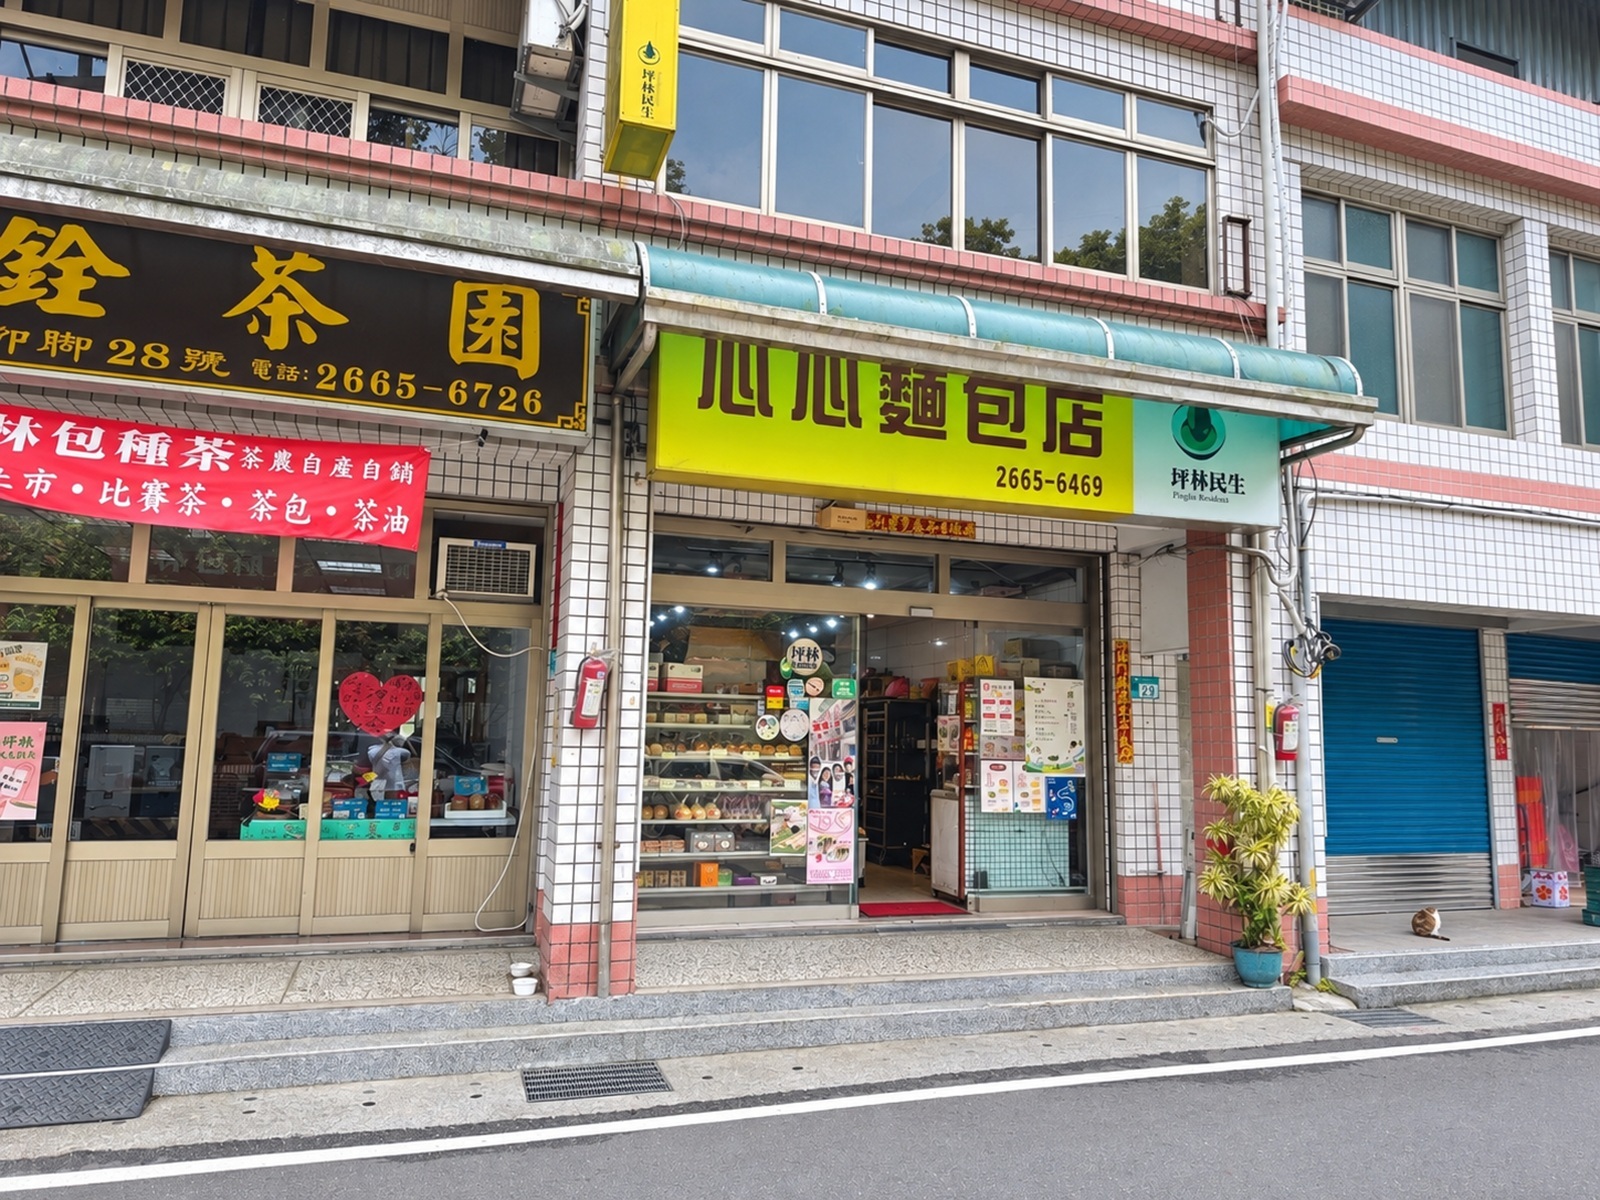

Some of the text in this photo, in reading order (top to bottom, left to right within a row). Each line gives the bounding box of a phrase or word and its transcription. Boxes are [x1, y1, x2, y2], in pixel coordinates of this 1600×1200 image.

[641, 68, 656, 120] 坪林民生
[315, 363, 543, 415] 2665-6726
[996, 465, 1104, 497] 2665-6469
[1171, 467, 1246, 495] 坪林民生
[98, 477, 207, 517] 比賽茶
[247, 488, 311, 526] 茶包
[351, 498, 410, 535] 茶油
[1141, 685, 1155, 697] 29
